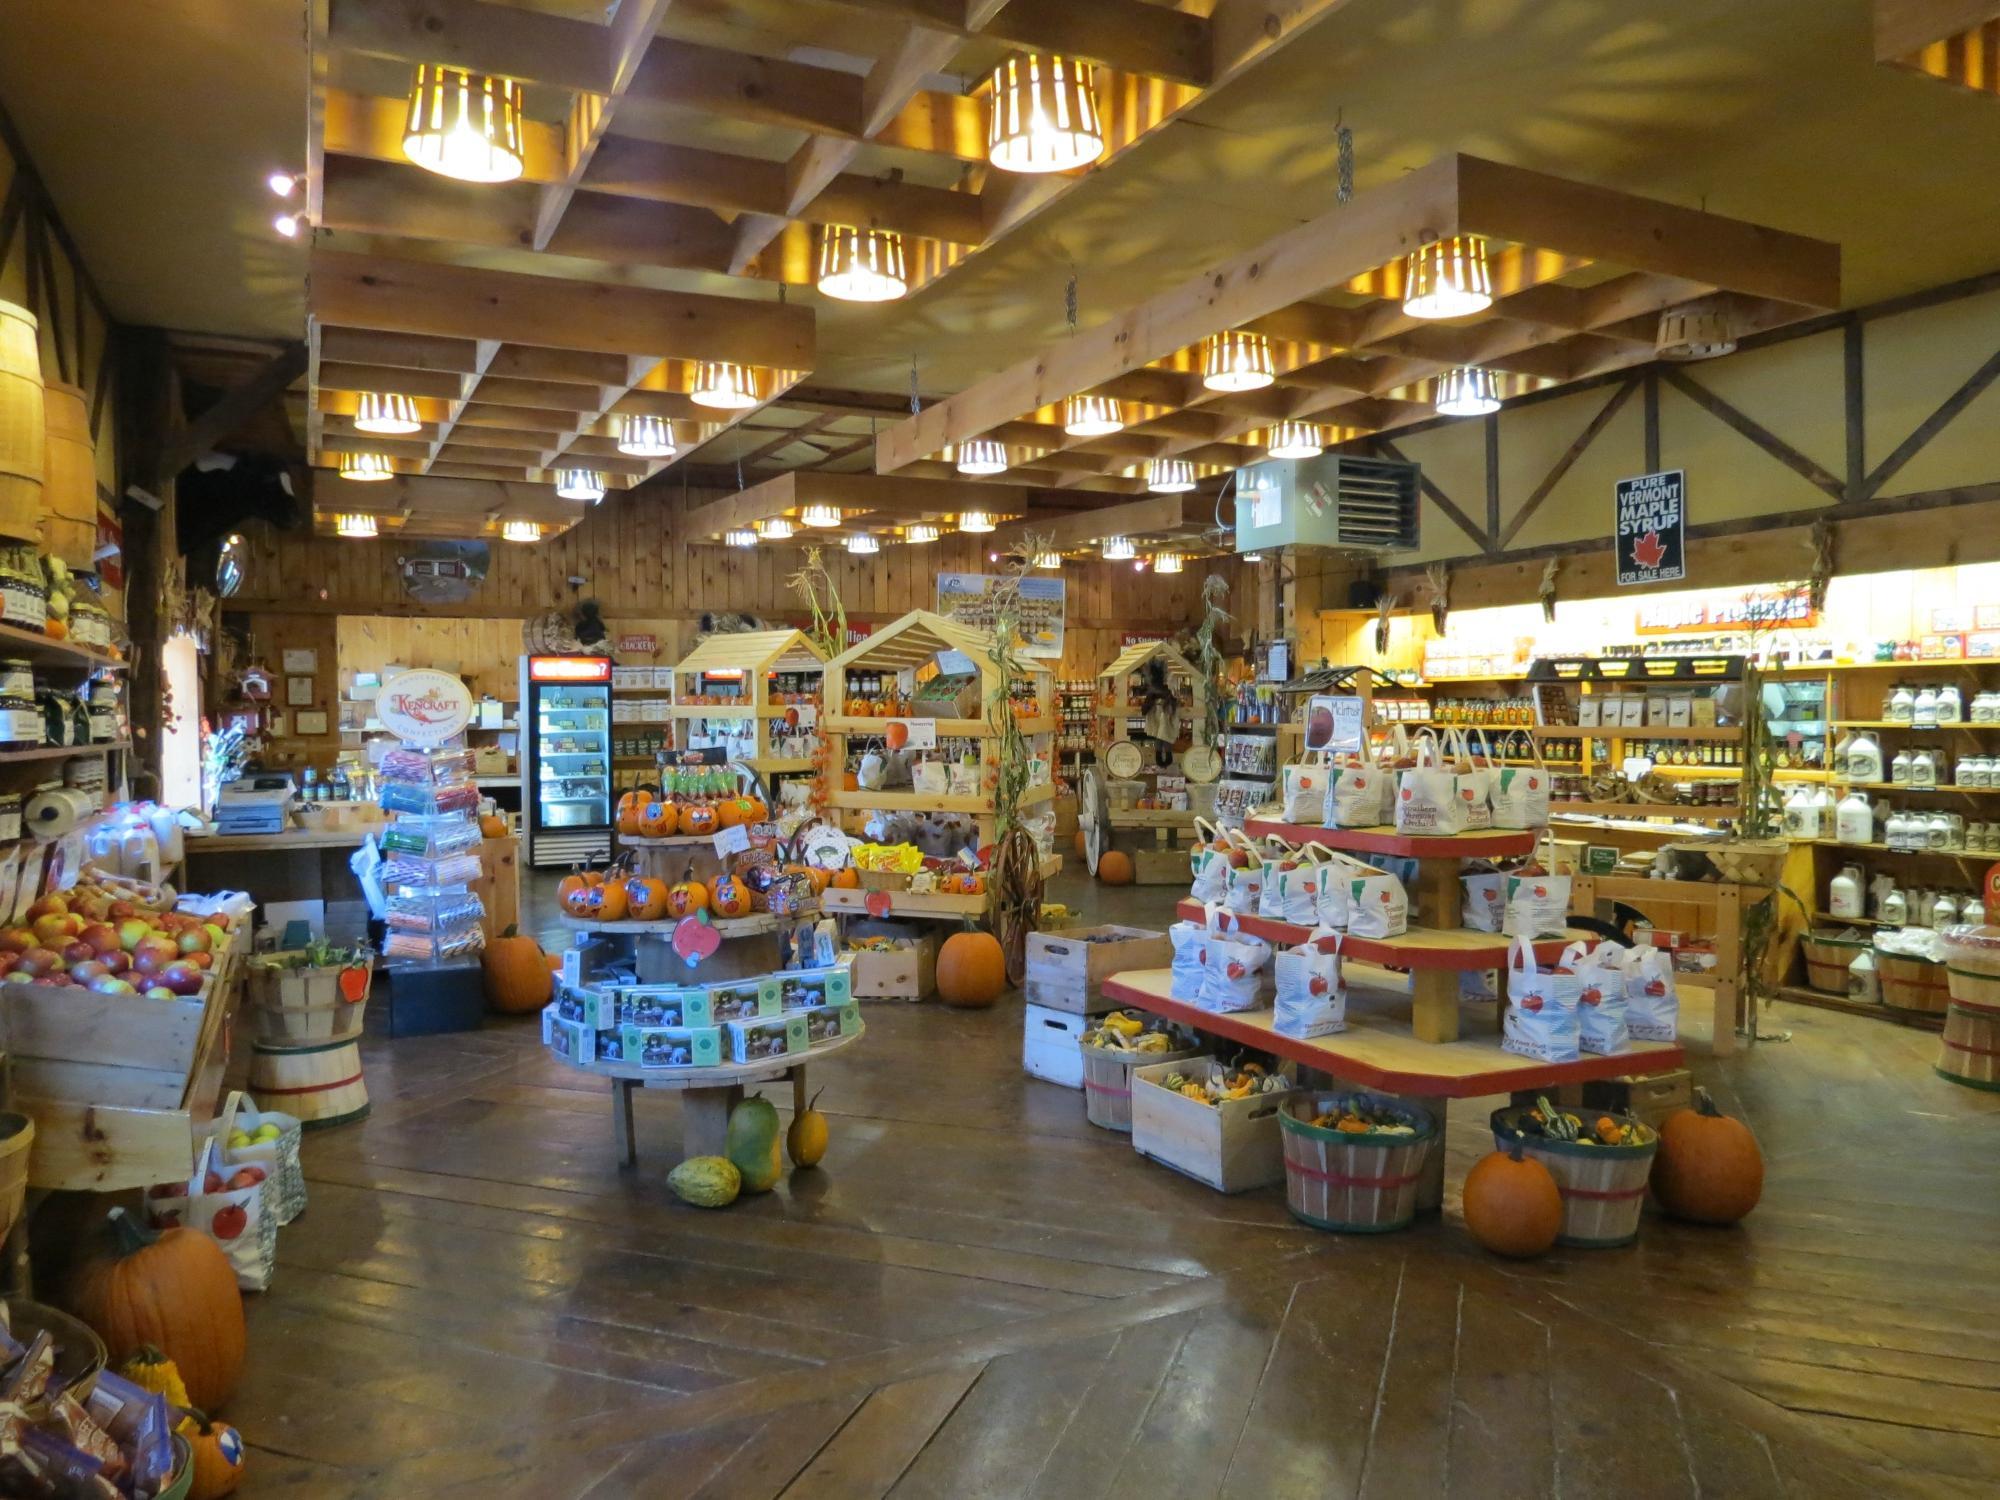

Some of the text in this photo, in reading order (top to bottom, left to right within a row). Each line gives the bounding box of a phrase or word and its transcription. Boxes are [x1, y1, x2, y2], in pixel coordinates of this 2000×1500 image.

[1631, 475, 1666, 491] PURE
[1620, 483, 1679, 506] VERMONT
[1620, 498, 1679, 521] MAPLE
[1619, 513, 1679, 536] SYRUP
[1621, 566, 1681, 583] FOR SALE HERE
[1126, 636, 1137, 646] No
